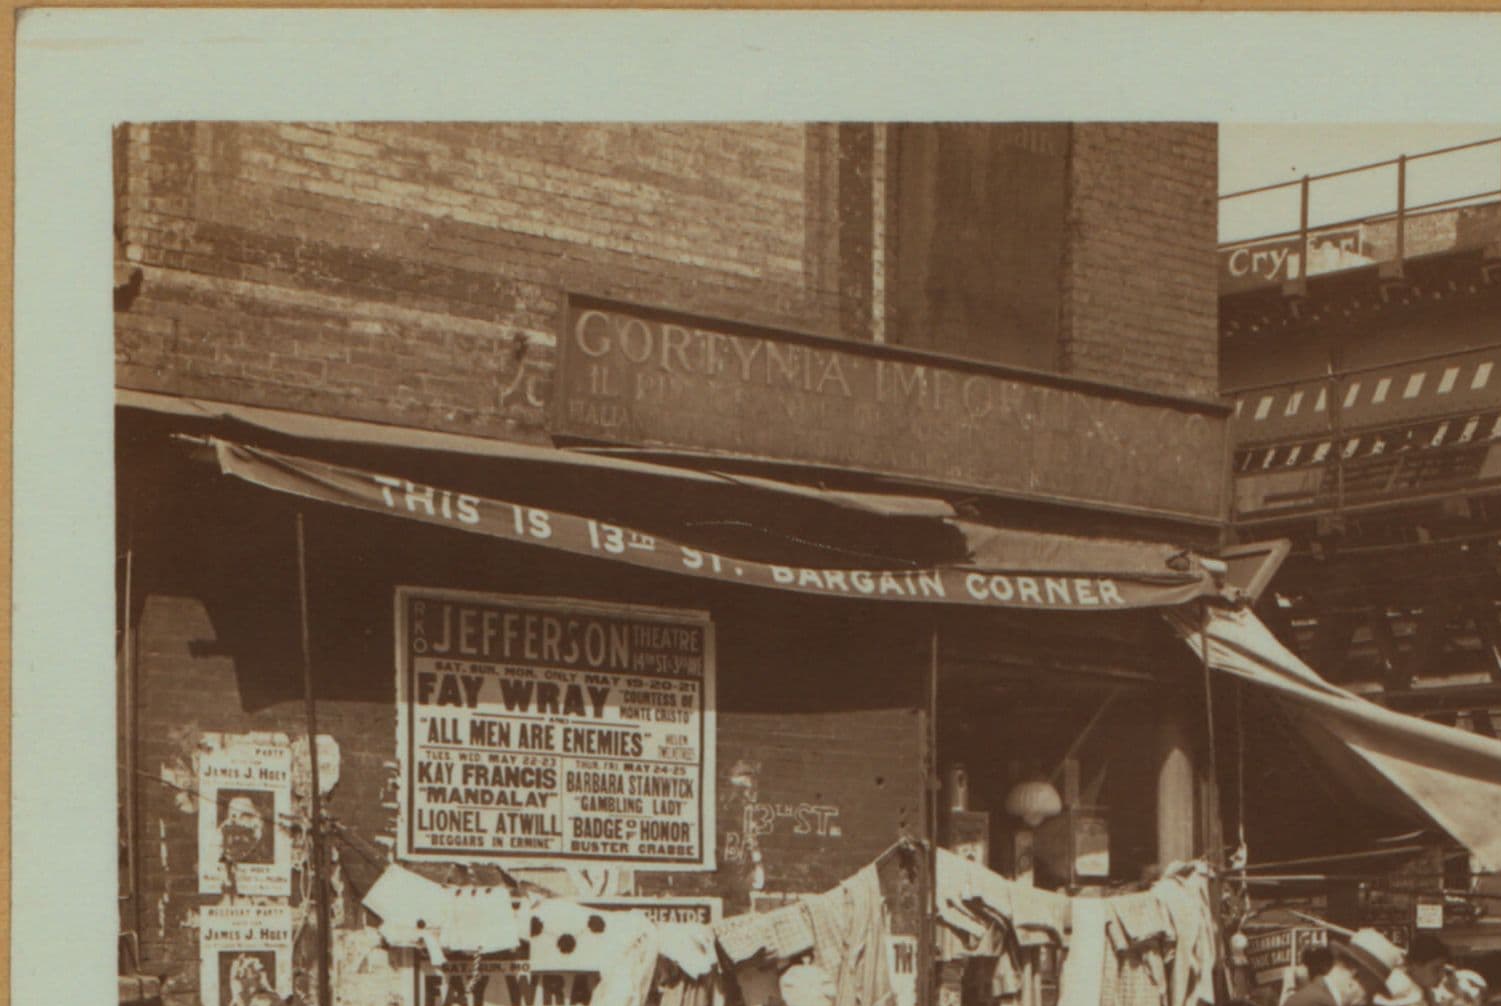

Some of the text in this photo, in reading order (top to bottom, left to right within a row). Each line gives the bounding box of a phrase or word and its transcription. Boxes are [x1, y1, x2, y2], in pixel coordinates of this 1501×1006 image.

[373, 475, 480, 524] THIS
[512, 504, 552, 538] IS
[769, 565, 946, 598] BARGAIN
[966, 572, 1127, 605] CORNER
[433, 605, 629, 670] JEFFERSON
[633, 624, 700, 652] THEATRE
[543, 669, 577, 682] ONLY
[584, 673, 621, 686] MAY
[417, 672, 611, 719] FAY WRAY
[469, 720, 511, 747] MEN
[518, 724, 556, 750] ARE
[488, 753, 517, 766] MAY
[624, 763, 651, 774] MAY
[417, 761, 557, 789] KAY FRANCIS
[566, 771, 694, 800] BARBARA STANWYCK
[417, 808, 562, 837] LIONEL ATWILL
[491, 836, 504, 849] IN
[570, 841, 695, 857] BUSTER CRABBE
[203, 928, 240, 941] JAMES
